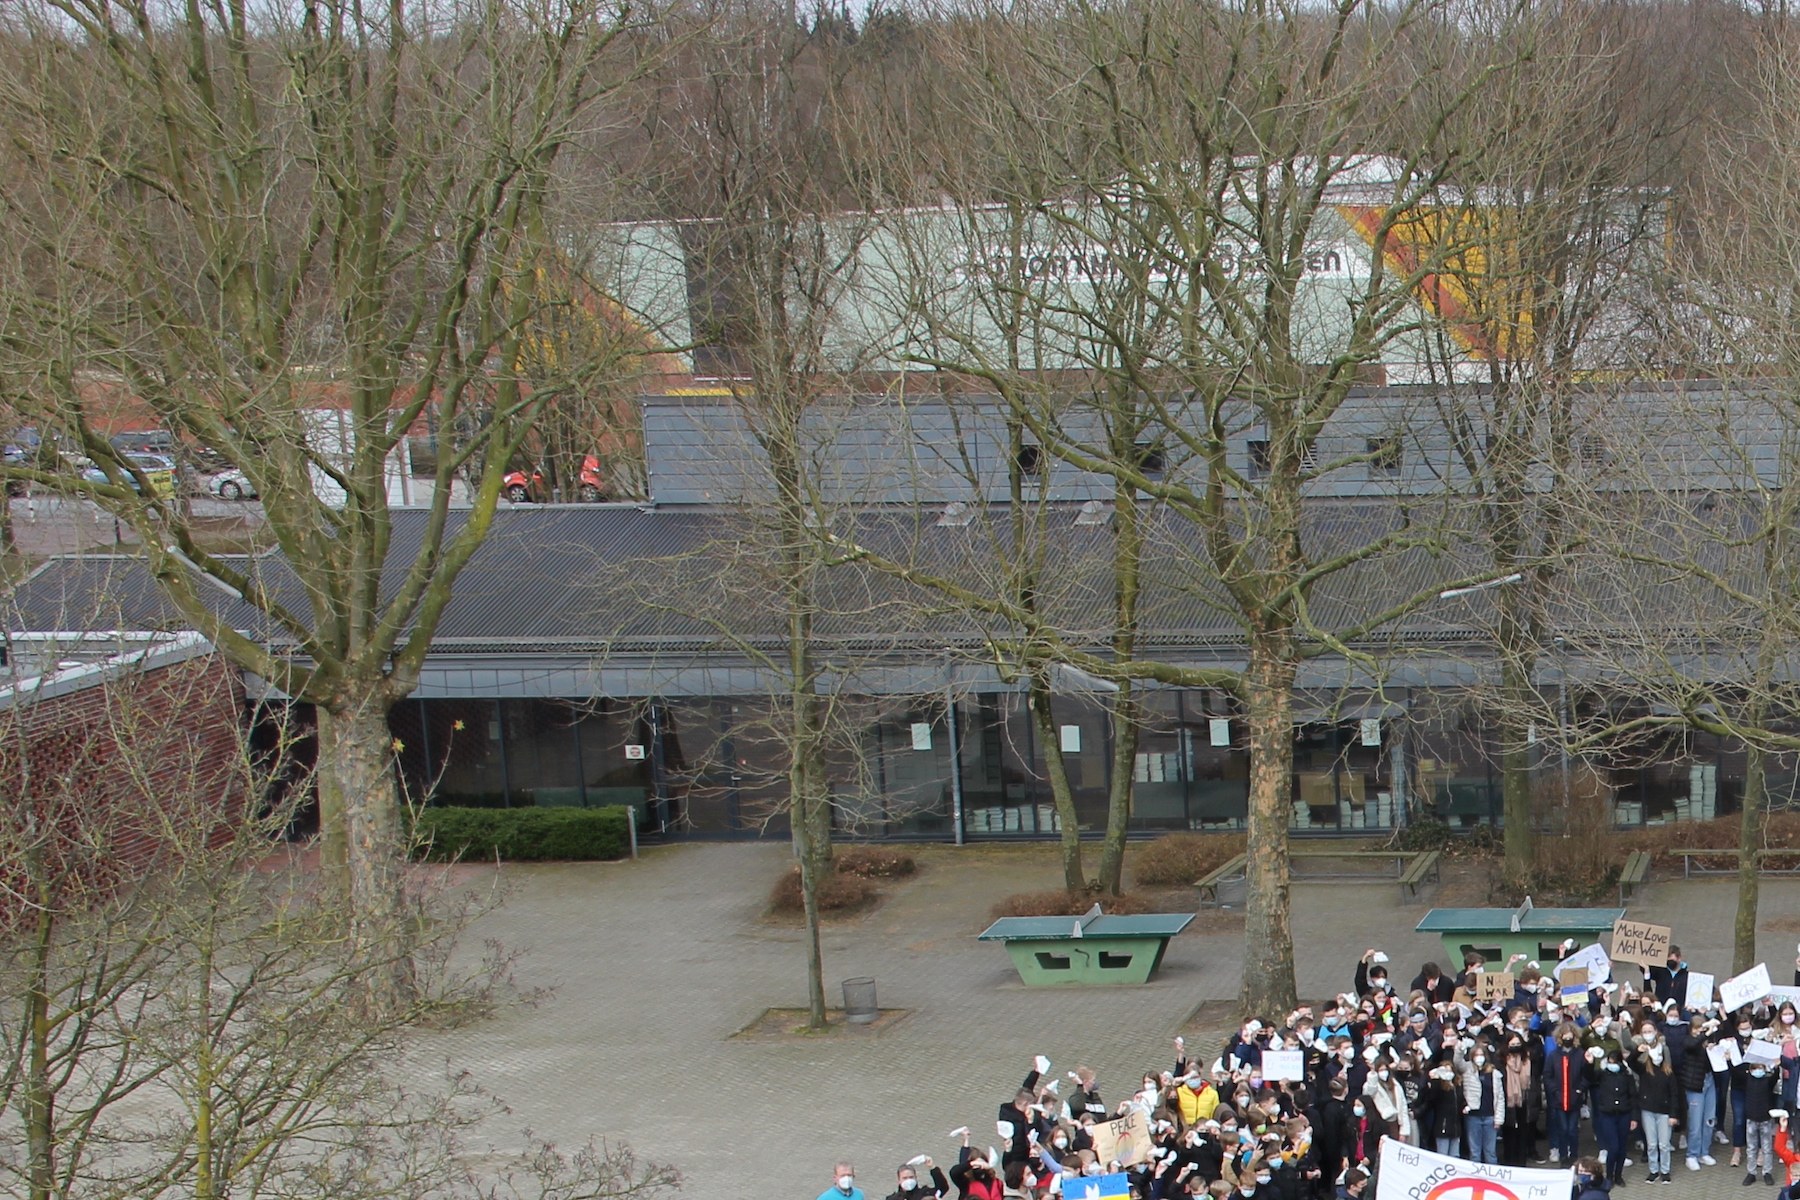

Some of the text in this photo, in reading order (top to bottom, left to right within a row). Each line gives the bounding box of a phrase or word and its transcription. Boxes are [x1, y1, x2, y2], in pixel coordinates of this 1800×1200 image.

[1616, 923, 1668, 944] Make Love
[1616, 940, 1662, 957] Not War
[1485, 987, 1508, 998] WAR
[1110, 1113, 1137, 1137] PEACE
[1398, 1148, 1420, 1167] fred
[1470, 1162, 1512, 1180] SALAM
